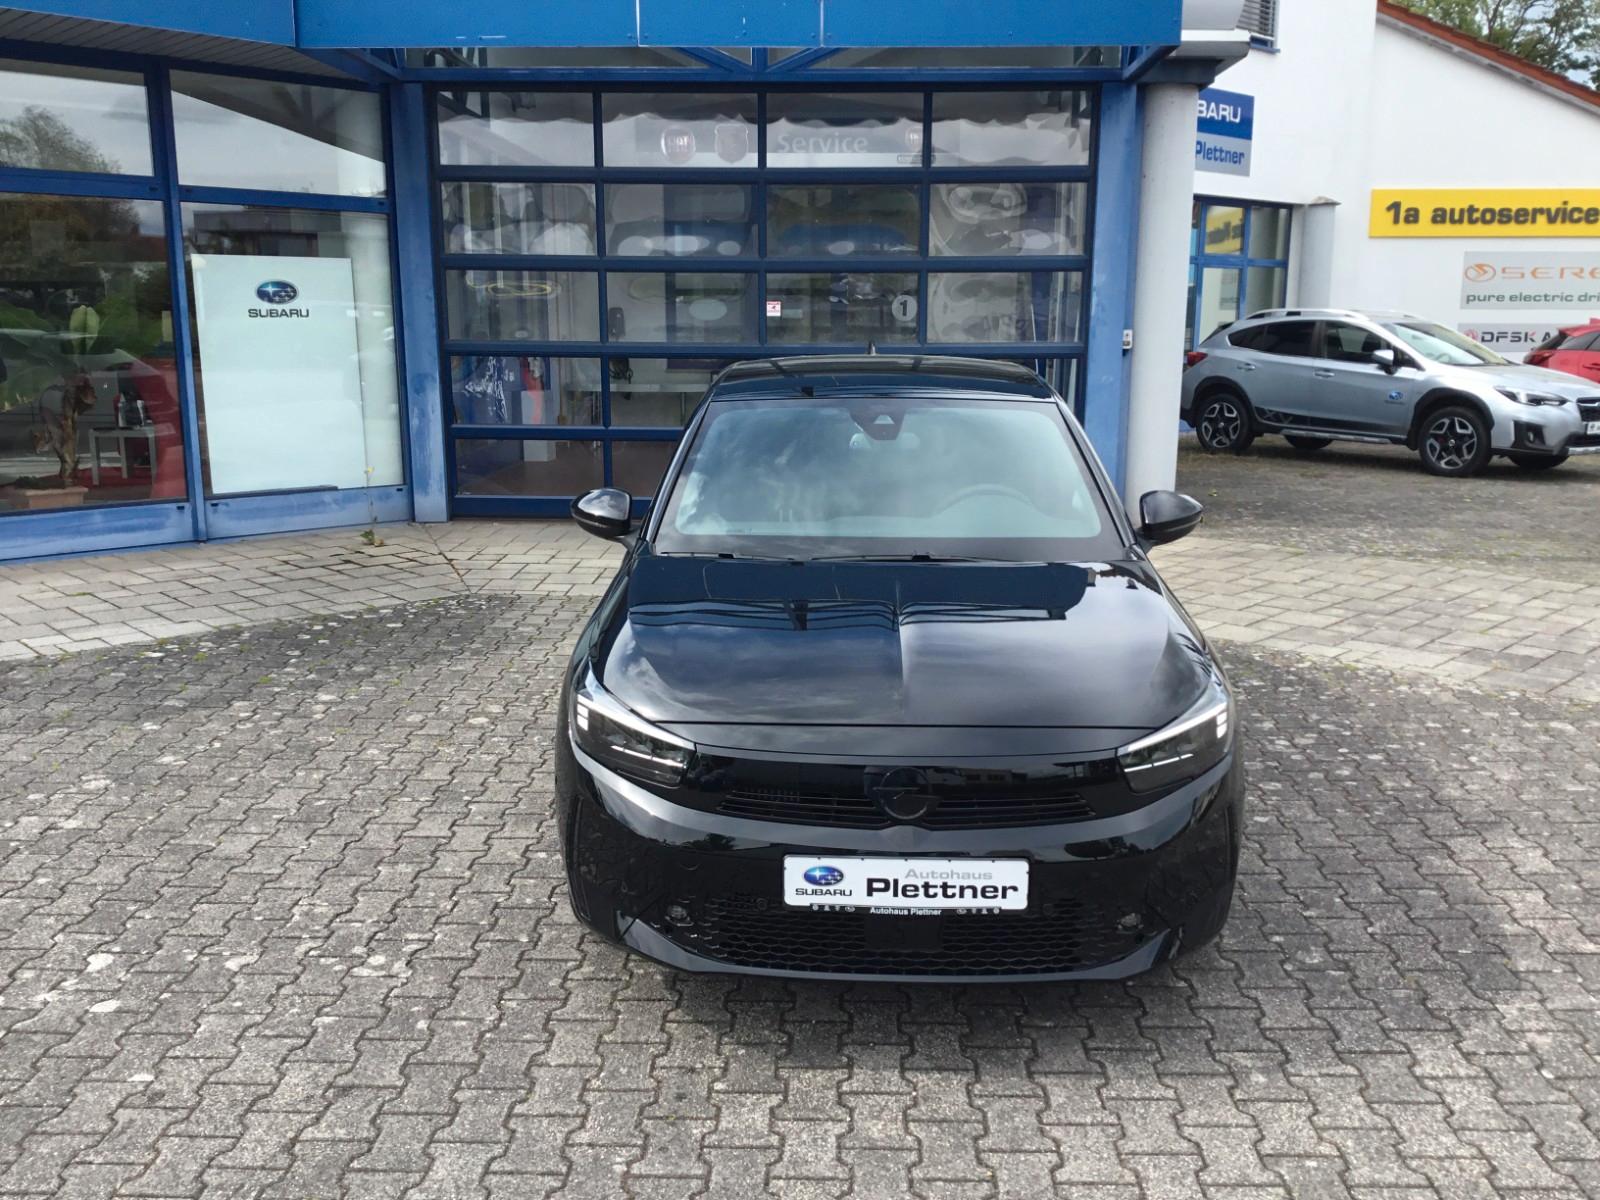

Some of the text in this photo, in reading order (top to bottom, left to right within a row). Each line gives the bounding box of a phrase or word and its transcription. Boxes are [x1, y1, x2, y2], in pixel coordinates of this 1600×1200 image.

[1197, 100, 1241, 123] BARU
[778, 132, 868, 152] Service
[1196, 140, 1245, 165] Plettner
[1385, 201, 1600, 225] 1a autoservice
[1466, 294, 1505, 304] pure
[1509, 292, 1574, 302] electric
[248, 308, 309, 318] SUBARU
[900, 300, 907, 317] 1
[1481, 331, 1536, 342] DFSK
[905, 868, 993, 880] Autohaus
[795, 878, 1019, 900] SUBARU Plettner
[870, 906, 942, 916] Autohaus Plettner
